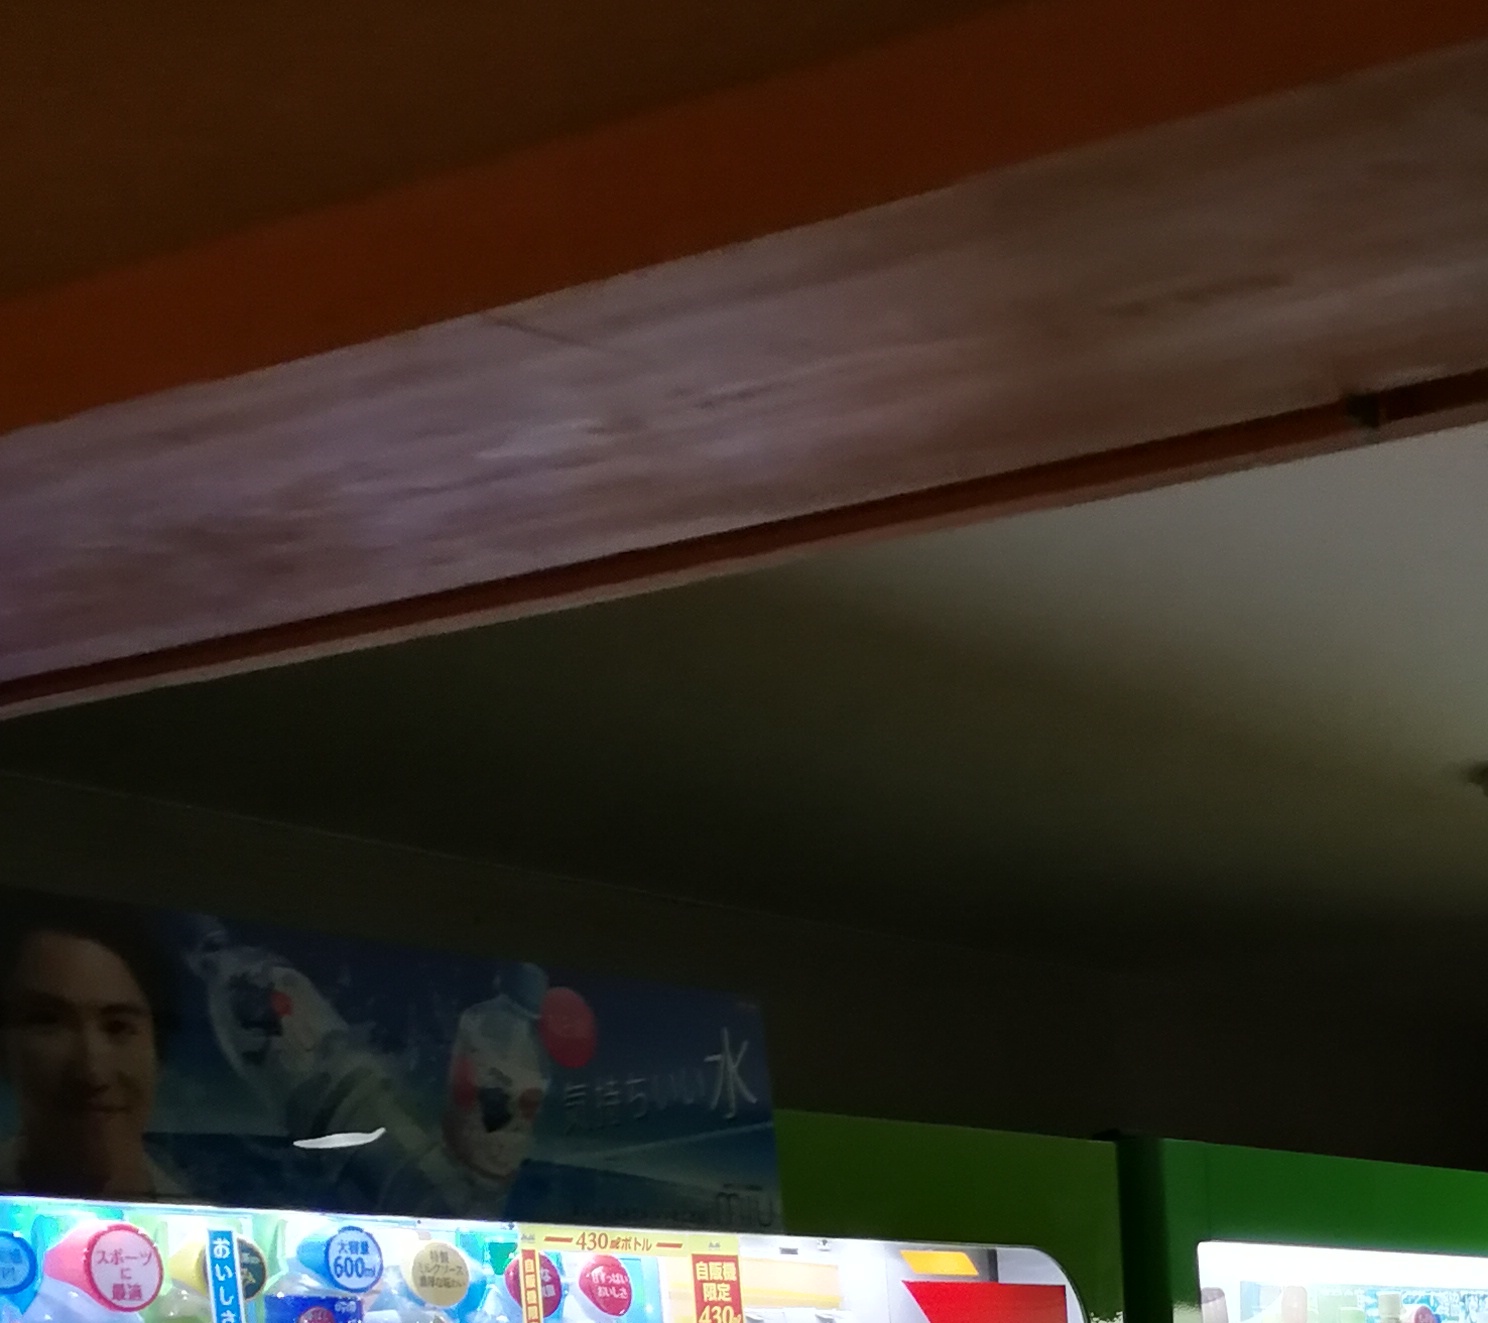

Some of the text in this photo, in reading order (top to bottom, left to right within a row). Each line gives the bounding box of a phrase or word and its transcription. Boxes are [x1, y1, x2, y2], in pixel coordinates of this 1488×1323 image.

[96, 1248, 153, 1266] スポーツ
[120, 1267, 132, 1282] に
[695, 1261, 738, 1282] 自販機
[703, 1283, 732, 1302] 限定
